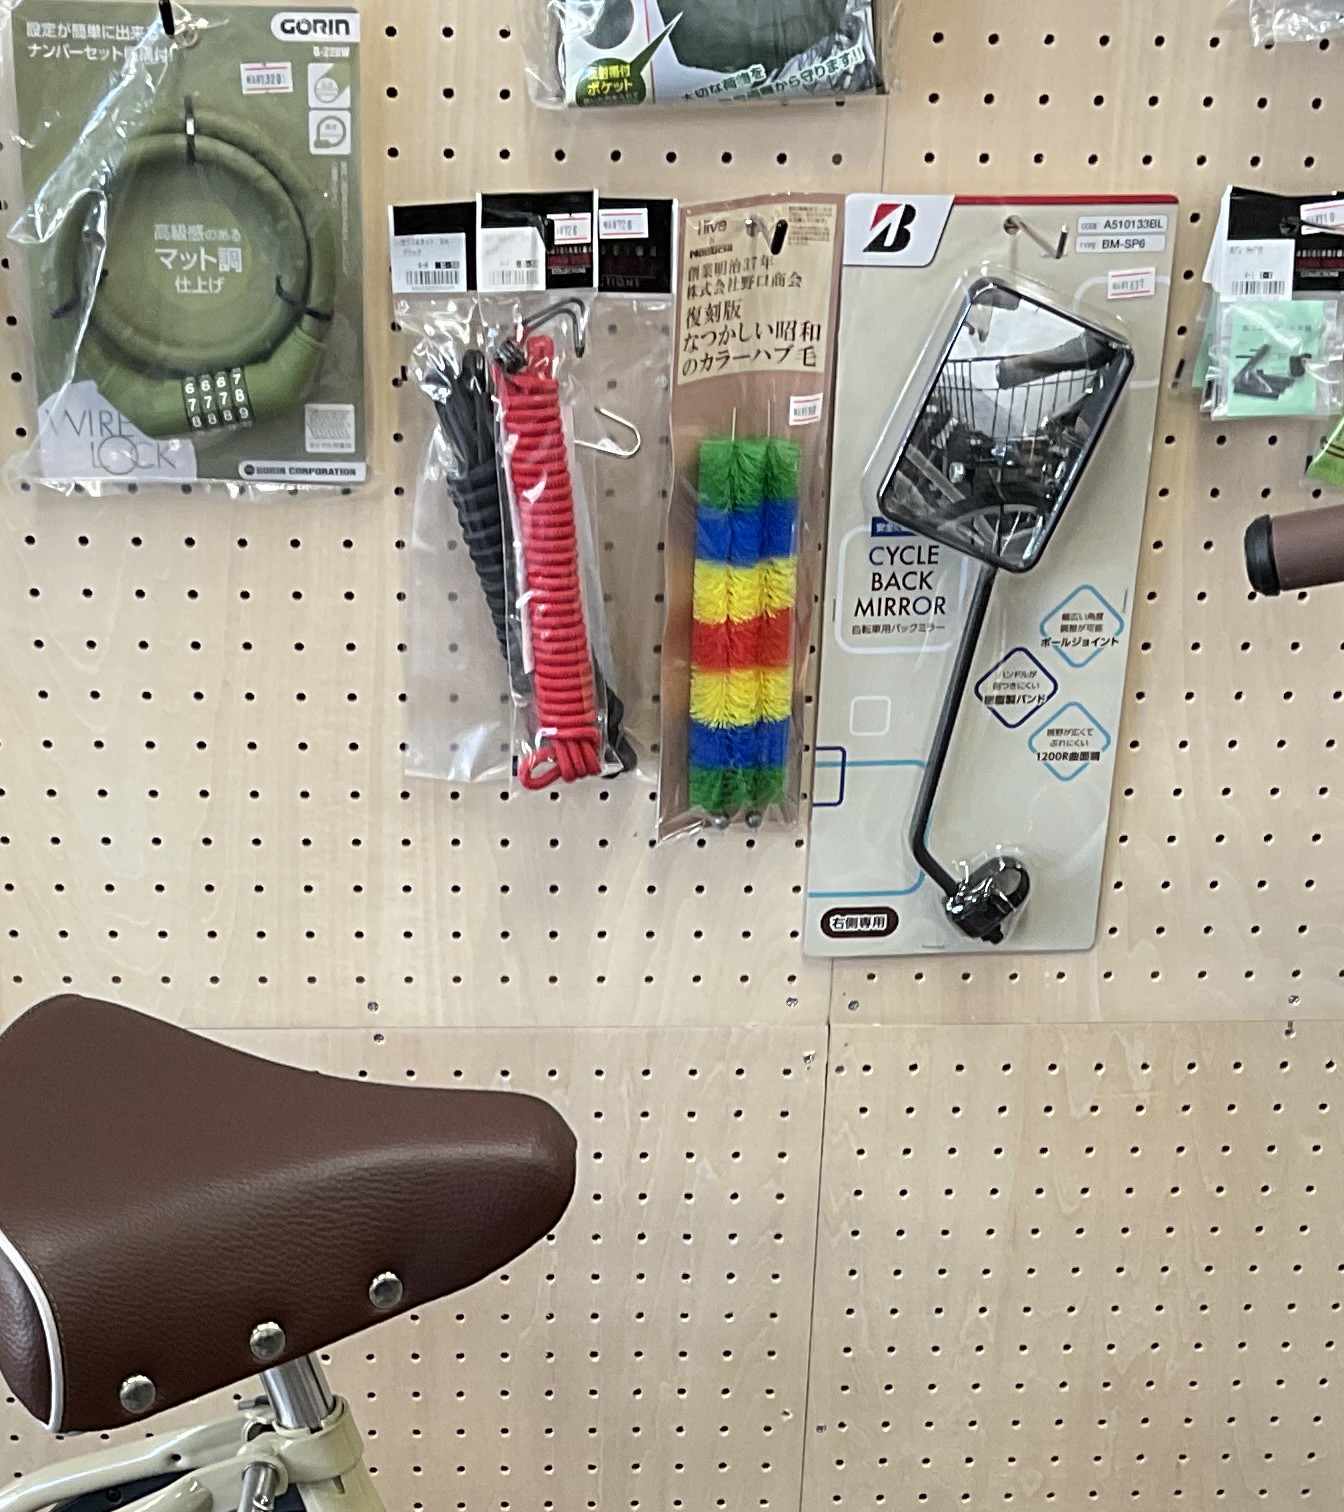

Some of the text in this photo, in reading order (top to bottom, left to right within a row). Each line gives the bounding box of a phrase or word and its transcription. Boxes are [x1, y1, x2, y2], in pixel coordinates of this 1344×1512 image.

[280, 18, 350, 35] GORIN
[155, 246, 243, 273] マット調
[175, 275, 225, 294] 仕上げ
[683, 320, 822, 353] なつかしい昭和
[682, 344, 817, 377] のカラーハブ毛
[869, 544, 940, 566] CYCLE
[871, 570, 934, 592] BACK
[854, 595, 946, 617] MIRROR
[851, 622, 946, 636] 自転車用バックミラー
[830, 914, 886, 931] 右側専用
